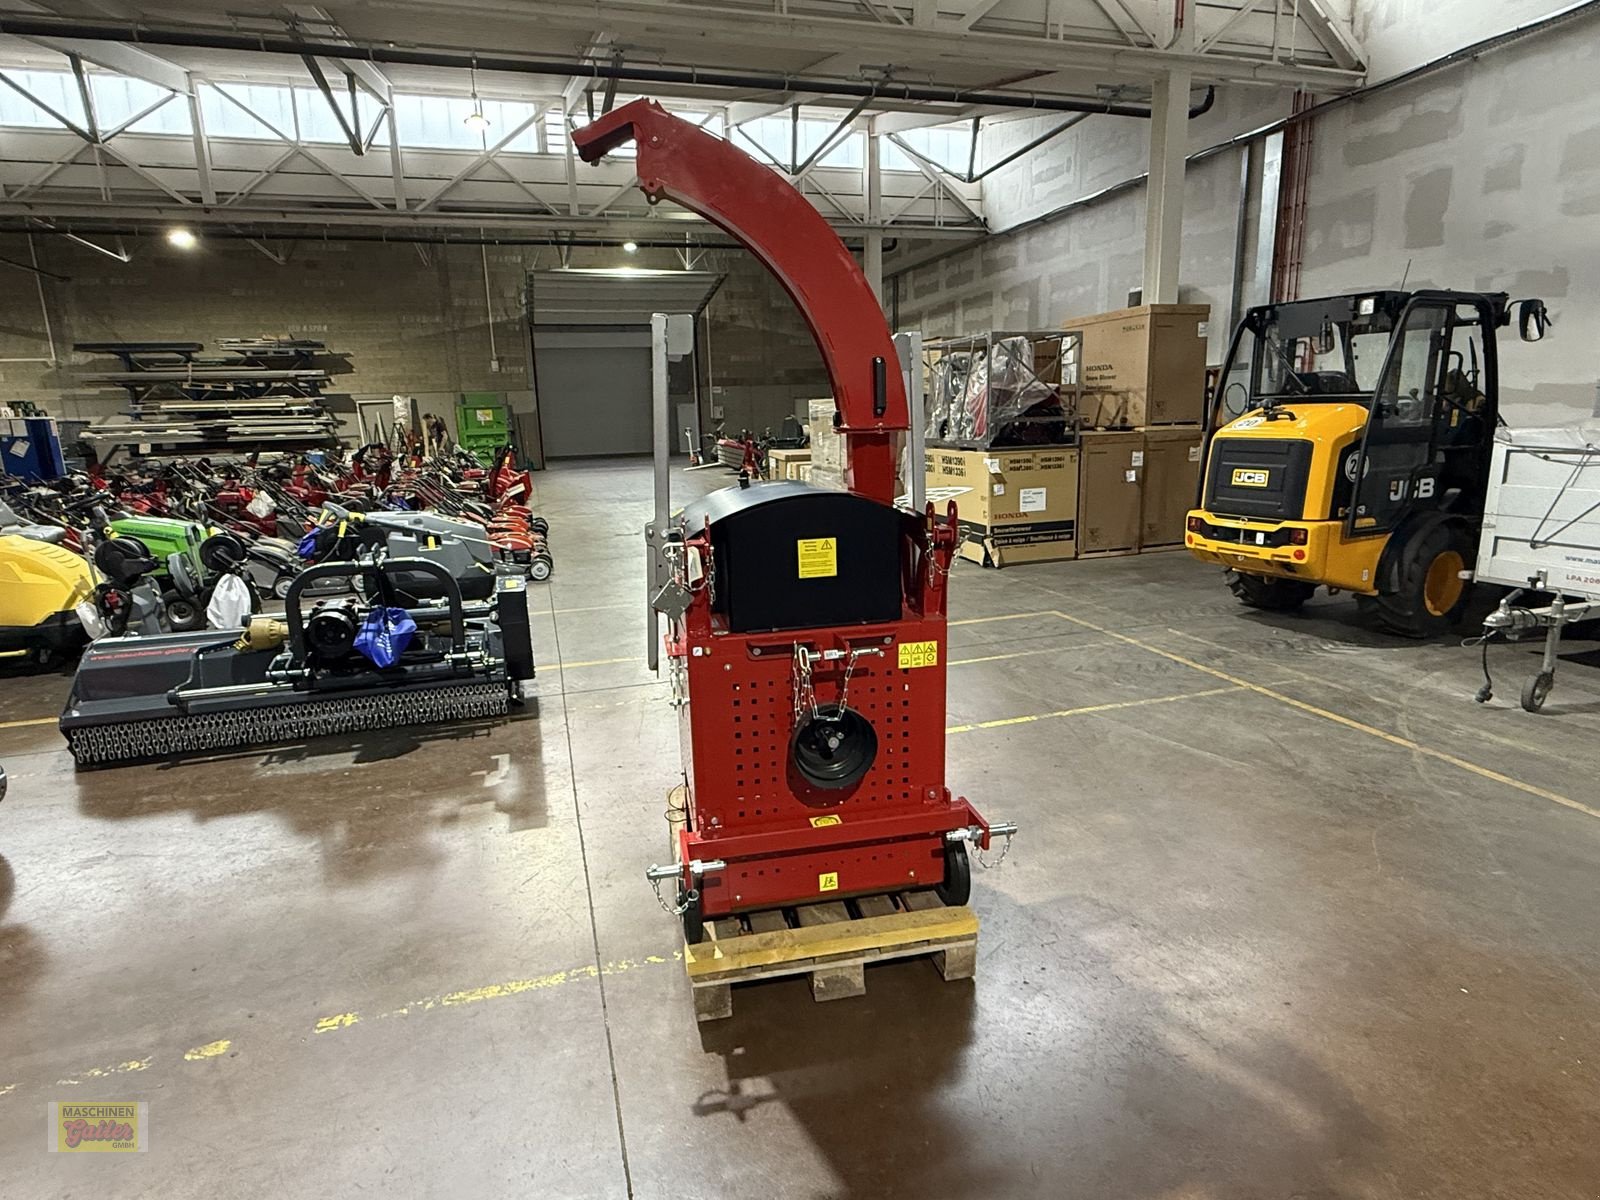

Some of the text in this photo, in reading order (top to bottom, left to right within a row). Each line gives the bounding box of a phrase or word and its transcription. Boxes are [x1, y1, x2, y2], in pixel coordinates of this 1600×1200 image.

[1085, 364, 1113, 372] HONDA
[1235, 471, 1267, 484] JCB
[994, 512, 1028, 520] HONDA
[993, 526, 1032, 534] Snowthrower
[1566, 574, 1582, 582] LPA
